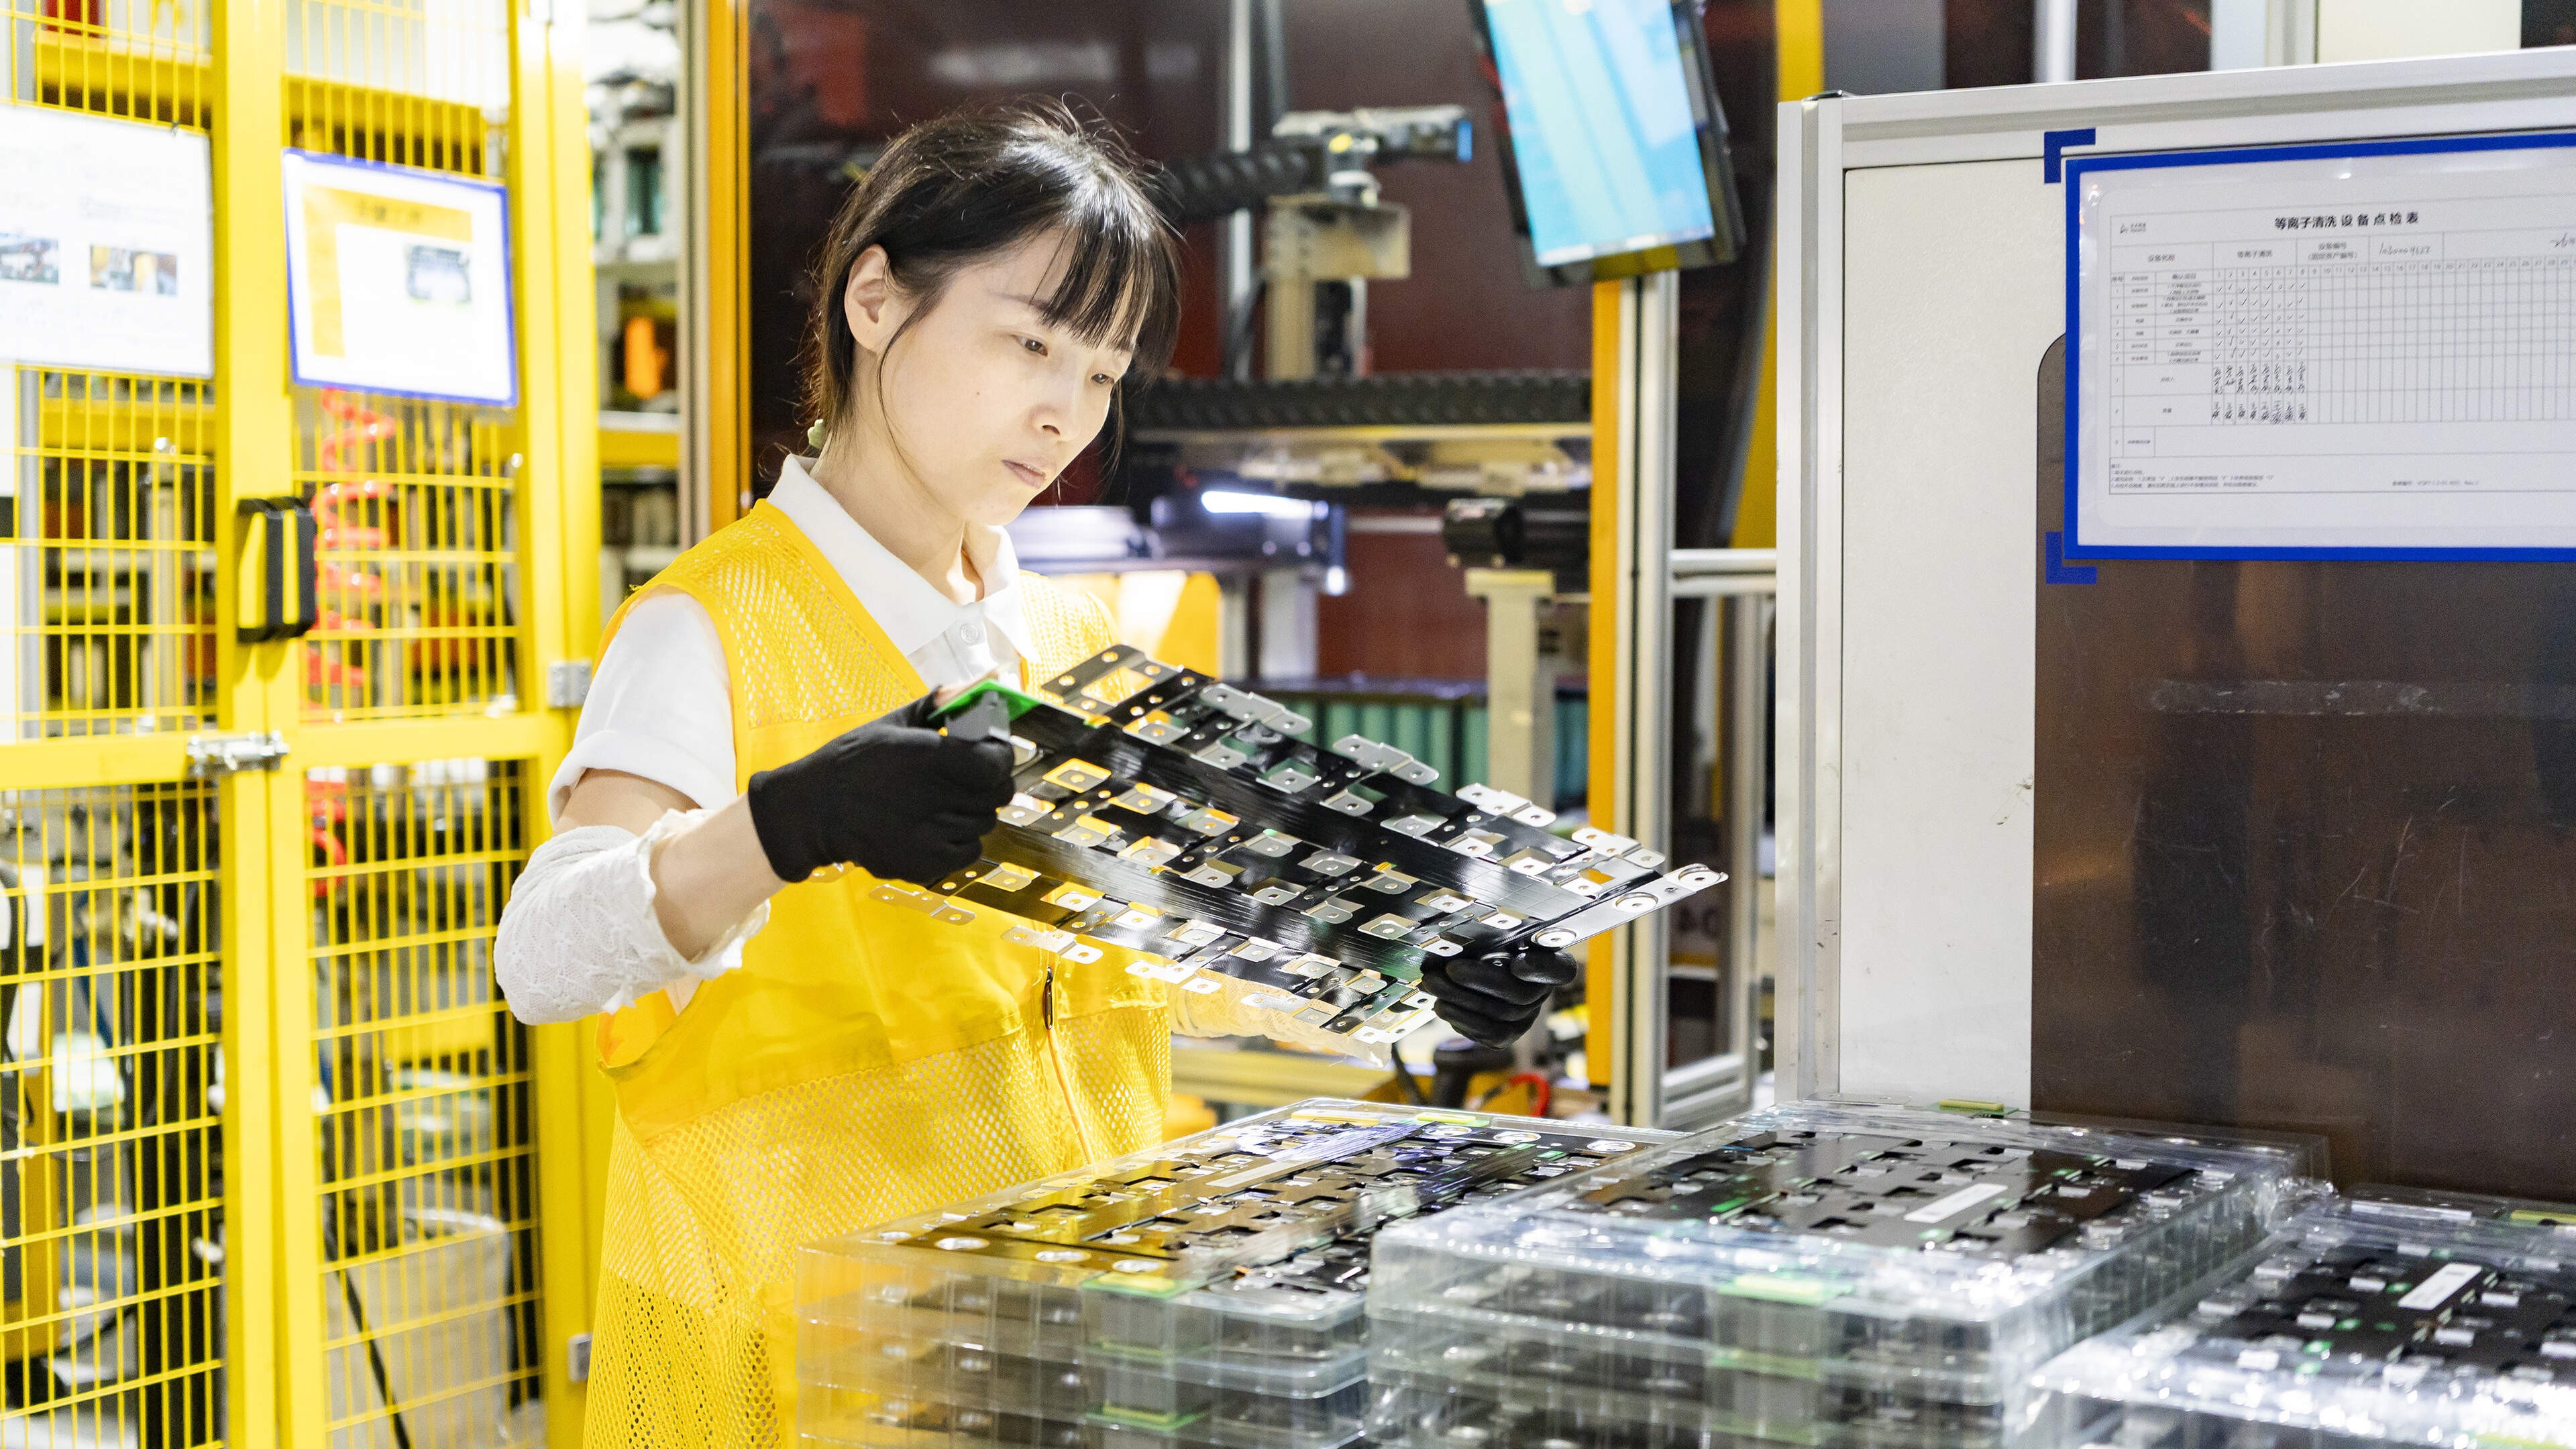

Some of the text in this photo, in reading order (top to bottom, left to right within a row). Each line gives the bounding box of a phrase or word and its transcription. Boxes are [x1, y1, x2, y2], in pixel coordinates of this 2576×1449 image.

[2275, 211, 2419, 229] 等离子清洗设备点检表
